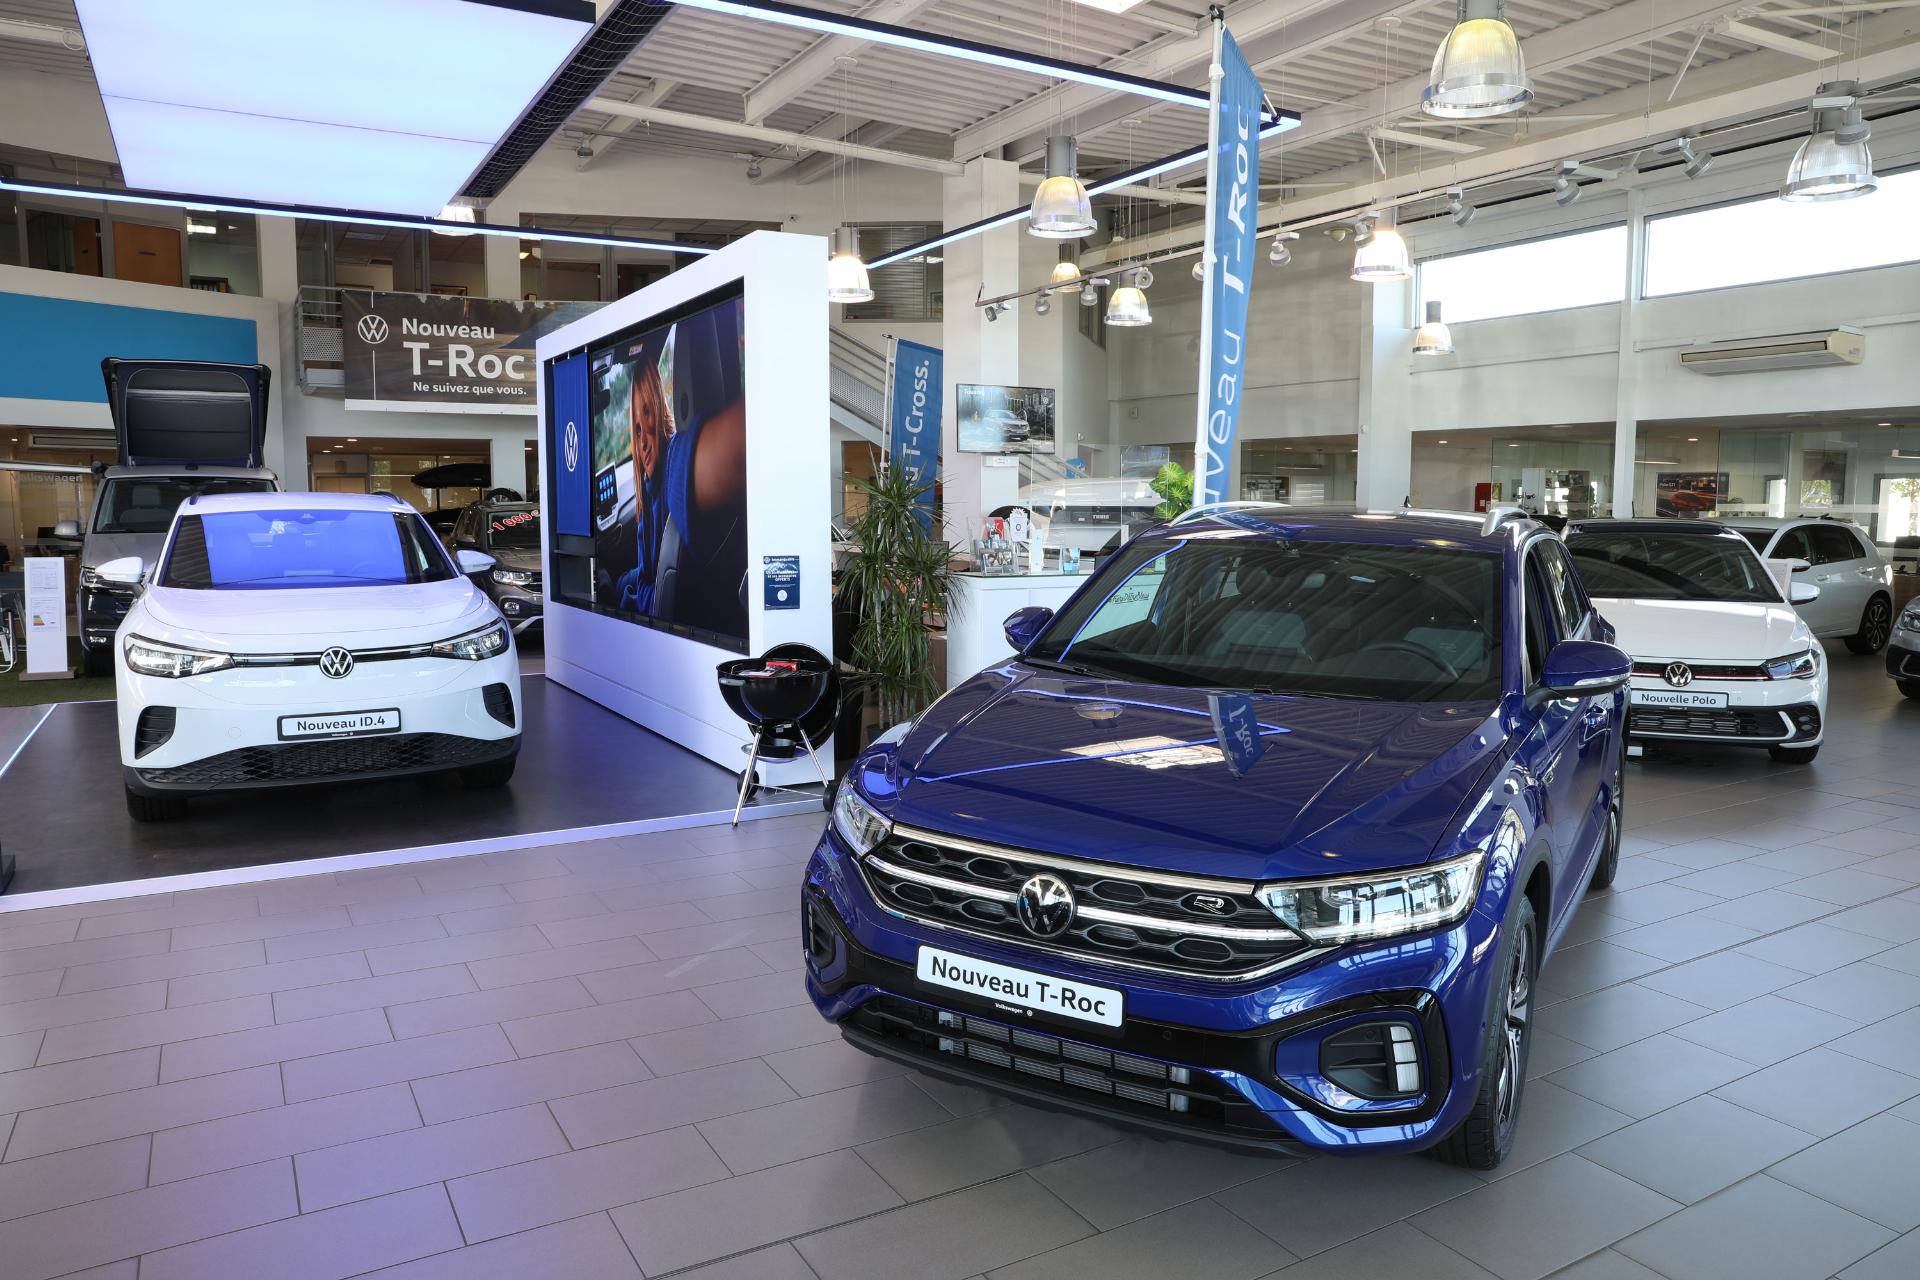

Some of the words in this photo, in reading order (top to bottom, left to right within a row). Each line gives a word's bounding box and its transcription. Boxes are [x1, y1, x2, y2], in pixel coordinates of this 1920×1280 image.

[1222, 105, 1249, 297] T-Roc
[402, 317, 495, 340] Nouveau
[403, 341, 525, 380] T-Roc
[413, 381, 430, 392] Ne
[432, 382, 470, 393] suivez
[472, 385, 494, 396] que
[496, 385, 527, 395] vous.
[903, 359, 930, 456] T-Cross.
[1641, 693, 1690, 704] Nouvelle
[1692, 695, 1717, 705] Polo
[297, 720, 356, 731] Nouveau
[360, 715, 386, 727] ID.4
[931, 956, 1029, 998] Nouveau
[1035, 981, 1106, 1016] T-Roc
